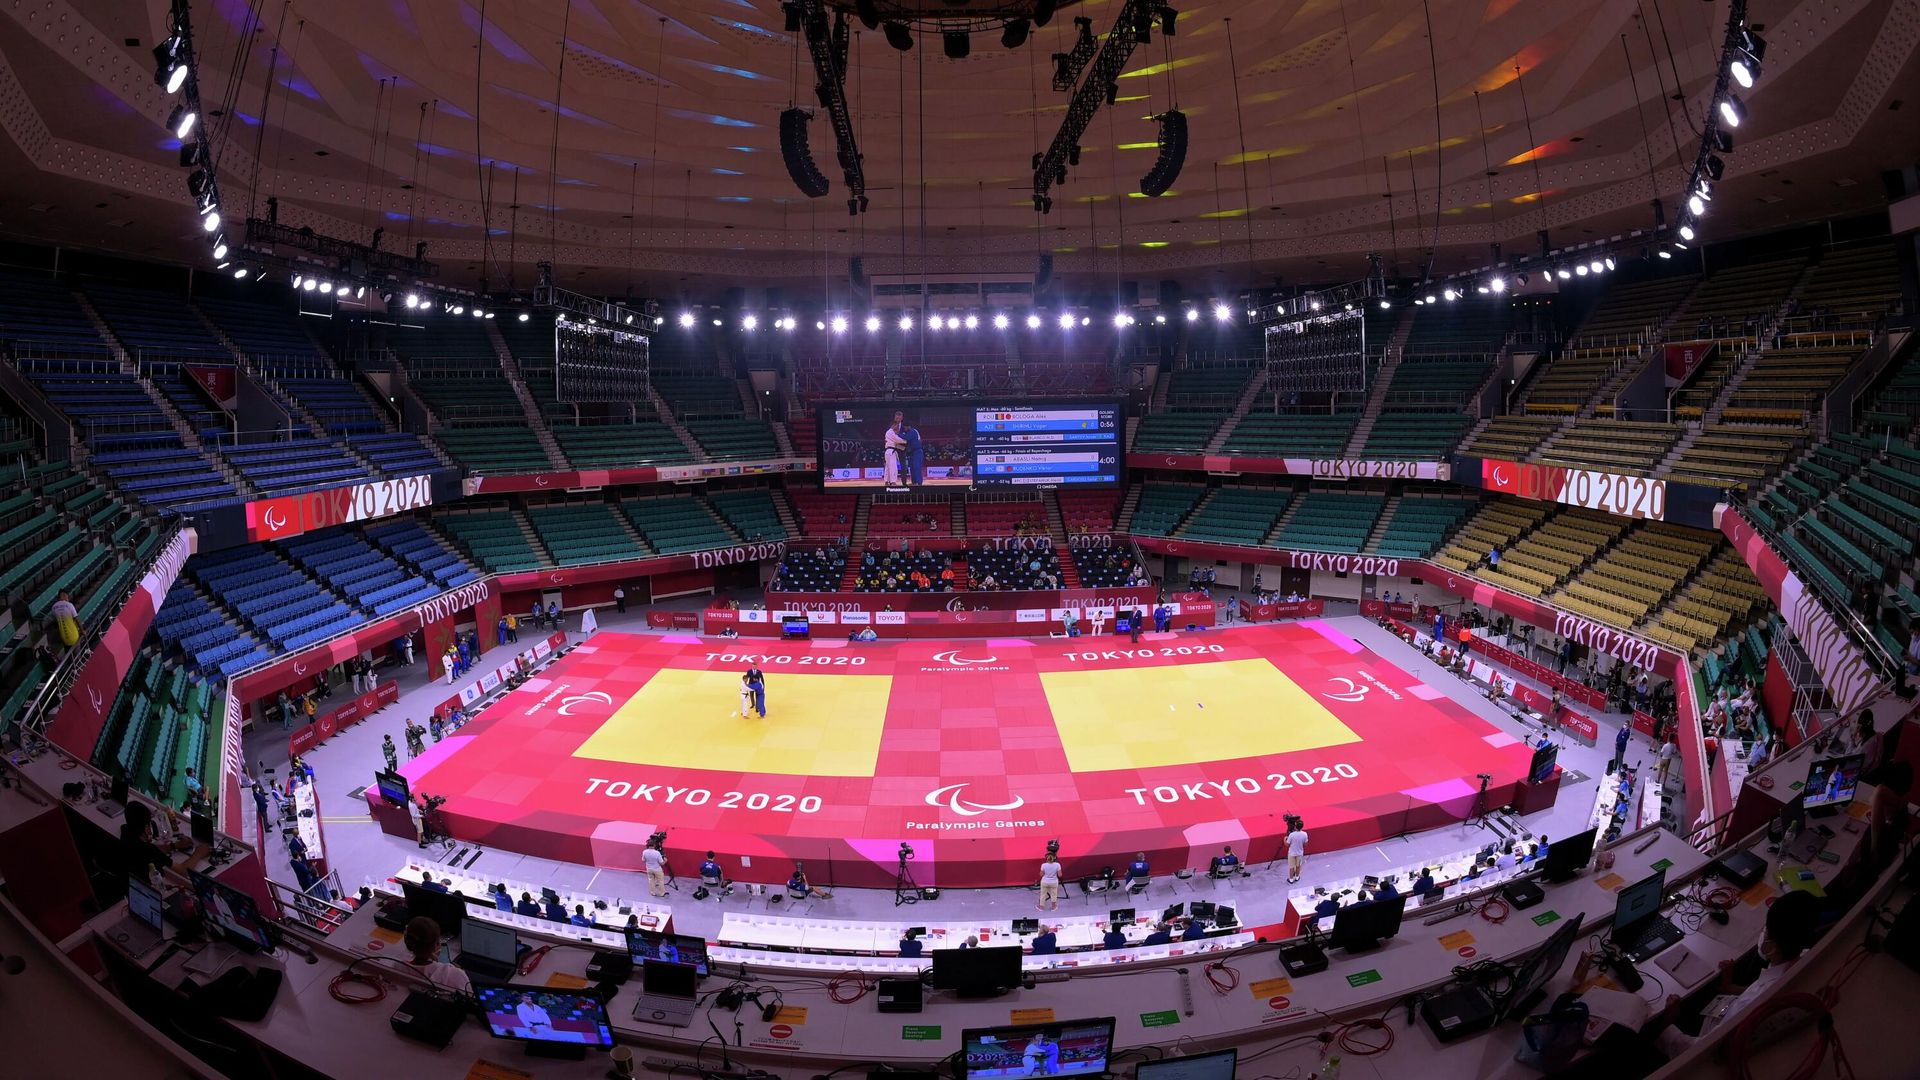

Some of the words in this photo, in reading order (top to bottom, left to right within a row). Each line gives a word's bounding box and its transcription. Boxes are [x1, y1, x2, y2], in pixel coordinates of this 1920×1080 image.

[1099, 456, 1115, 464] 4:00
[1310, 459, 1367, 477] TOKYO
[1372, 461, 1418, 479] 2020
[292, 482, 378, 530] TOKYO
[382, 474, 433, 518] 2020
[1514, 462, 1591, 505] TOKYO
[1598, 473, 1667, 520] 2020
[1070, 533, 1113, 551] 2020
[690, 547, 746, 569] TOKYO
[1289, 551, 1348, 573] TOKYO
[1351, 556, 1399, 577] 2020
[413, 594, 459, 628] TOKYO
[457, 582, 489, 608] 2020
[828, 601, 861, 612] 2020
[1063, 597, 1105, 609] TOKYO
[1108, 595, 1139, 607] 2020
[1554, 611, 1609, 653] TOKYO
[1610, 634, 1659, 672] 2020
[1792, 585, 1841, 680] TOKYO
[704, 653, 794, 665] TOKYO
[797, 653, 867, 667] 2020
[1062, 648, 1153, 663] TOKYO
[1159, 643, 1226, 657] 2020
[1124, 776, 1263, 806] TOKYO
[1266, 762, 1360, 790] 2020
[584, 777, 712, 806] TOKYO
[716, 790, 823, 814] 2020
[905, 819, 991, 832] Paralympic
[994, 817, 1046, 830] Games
